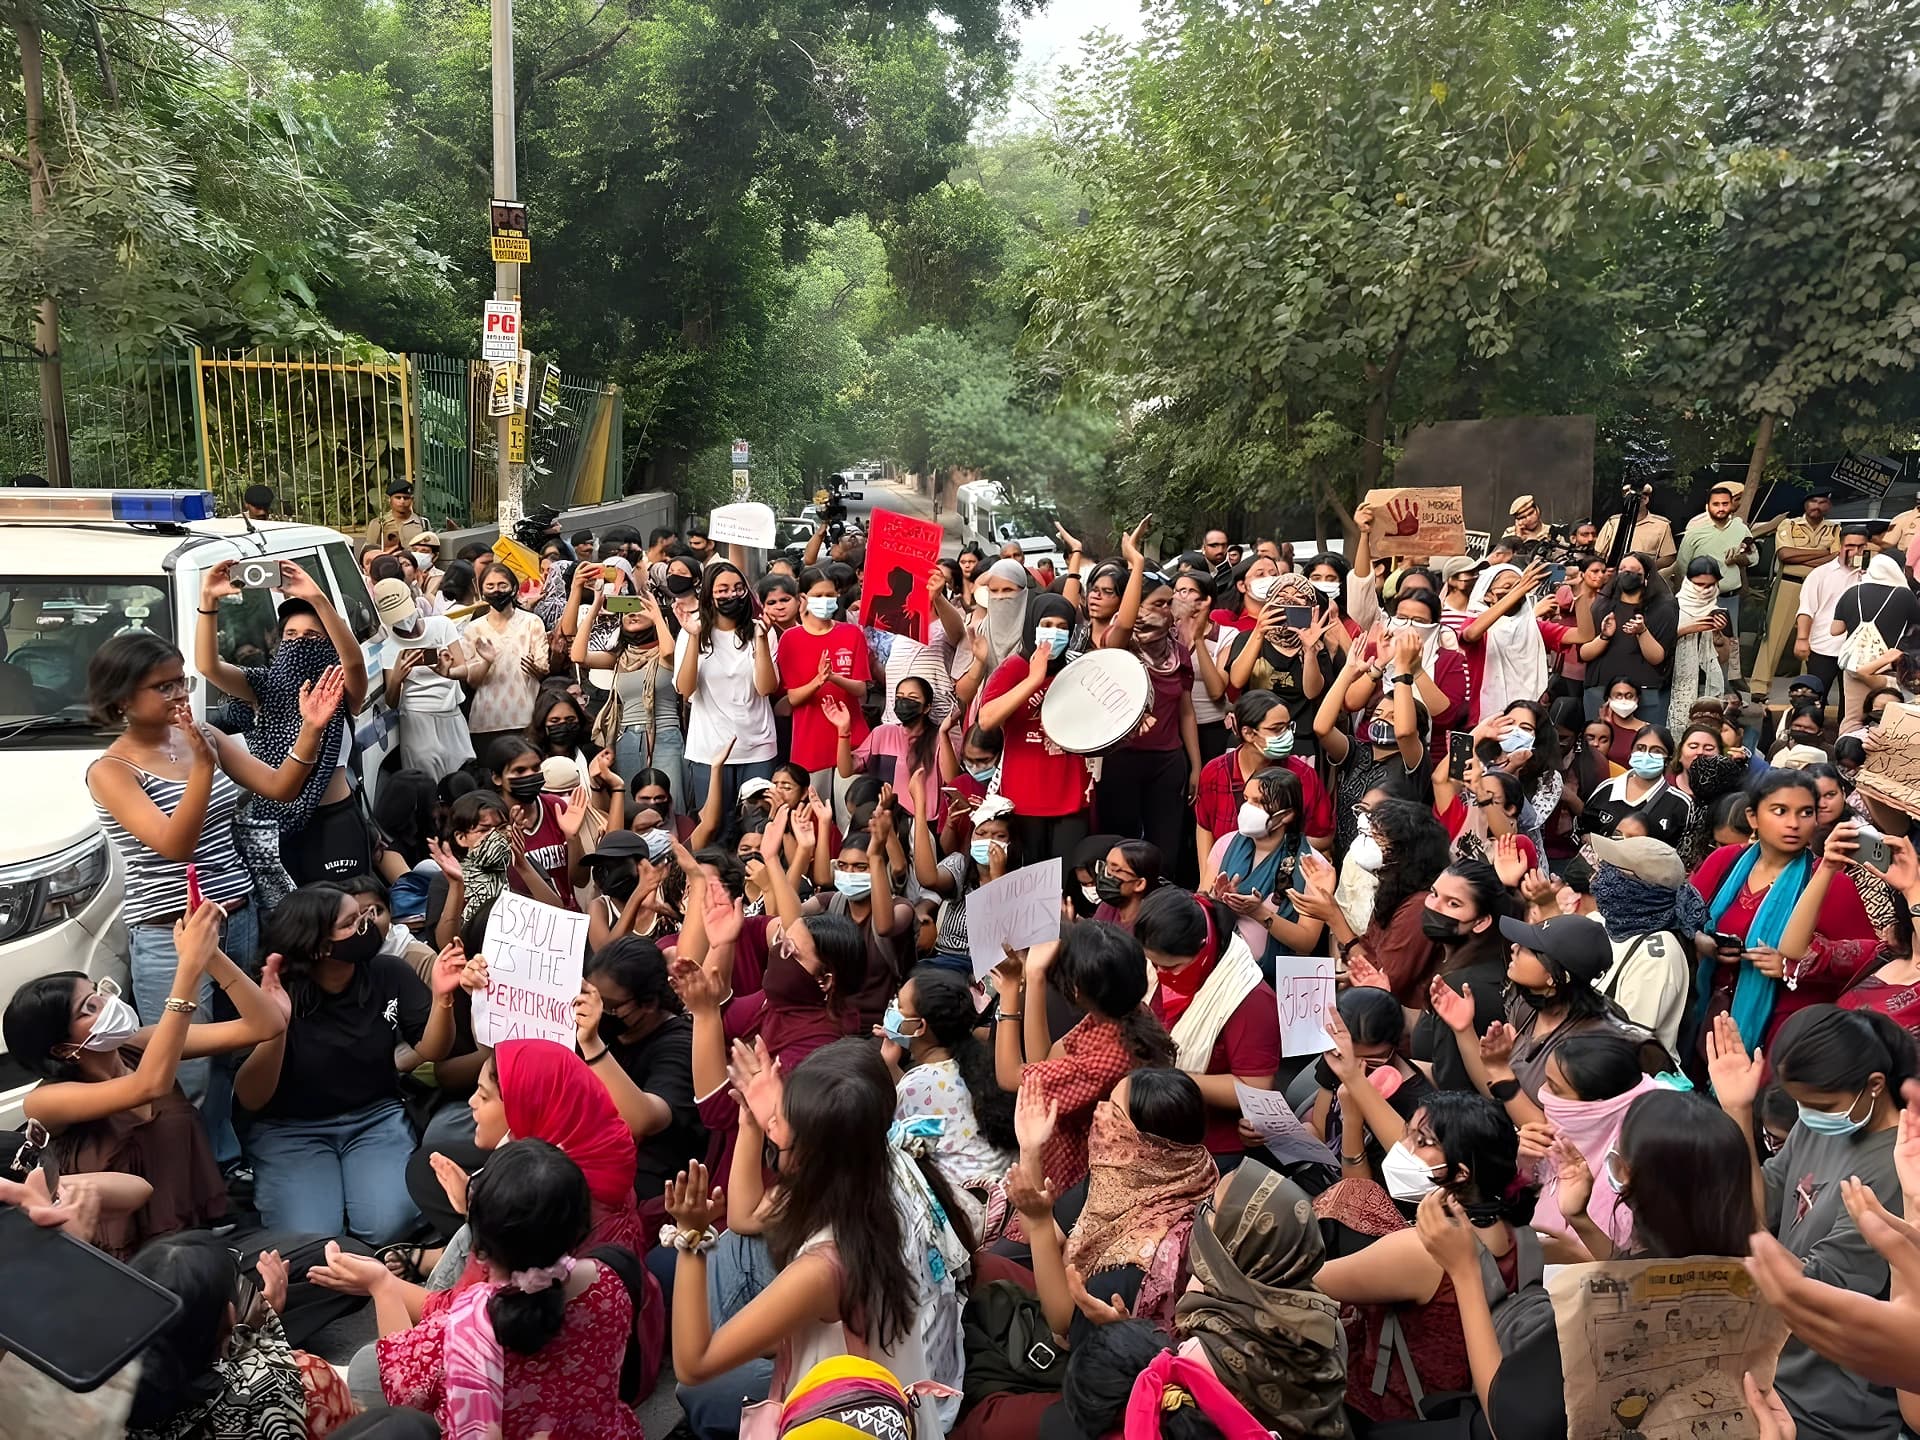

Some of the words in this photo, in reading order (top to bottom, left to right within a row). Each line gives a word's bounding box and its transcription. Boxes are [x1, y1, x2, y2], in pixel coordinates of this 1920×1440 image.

[487, 313, 516, 333] PG
[492, 897, 585, 956] ASSAULT
[491, 939, 516, 973] IS
[526, 949, 566, 986] THE
